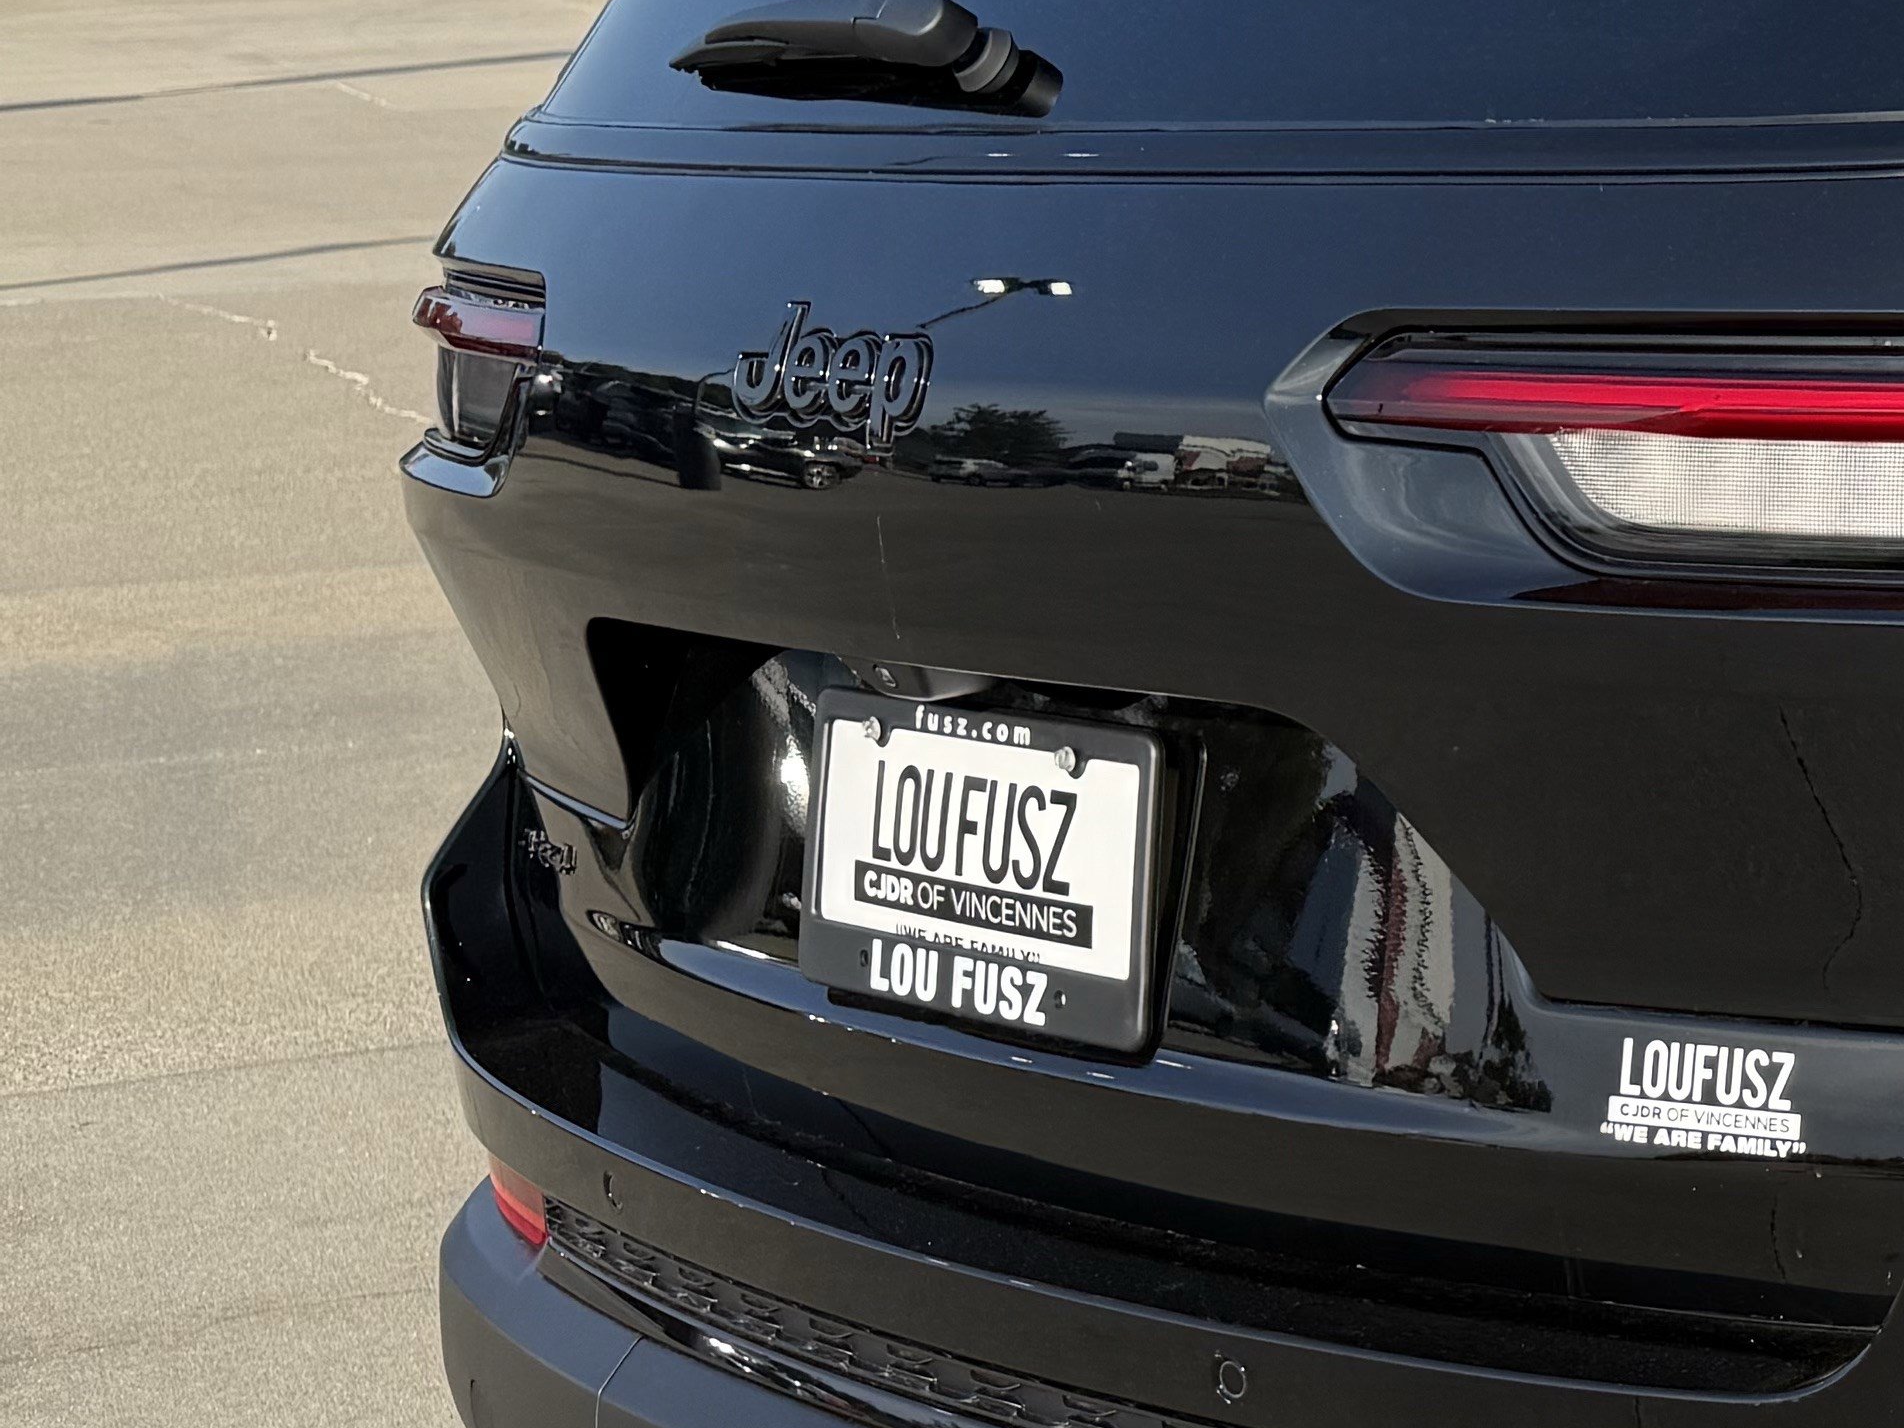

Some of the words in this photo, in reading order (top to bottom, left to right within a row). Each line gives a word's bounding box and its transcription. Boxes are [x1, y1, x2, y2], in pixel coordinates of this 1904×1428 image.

[732, 300, 934, 457] Jeep
[914, 704, 1031, 746] fusz.com
[863, 870, 914, 906] CJDR
[917, 881, 945, 911] OF
[950, 888, 1078, 939] VINCENNES
[869, 938, 939, 1002] LOU
[950, 955, 1048, 1027] FUSZ
[1620, 1103, 1662, 1120] CJDR
[1666, 1107, 1690, 1122] OF
[1694, 1109, 1790, 1133] VINCENNES
[1653, 1128, 1703, 1149] ARE
